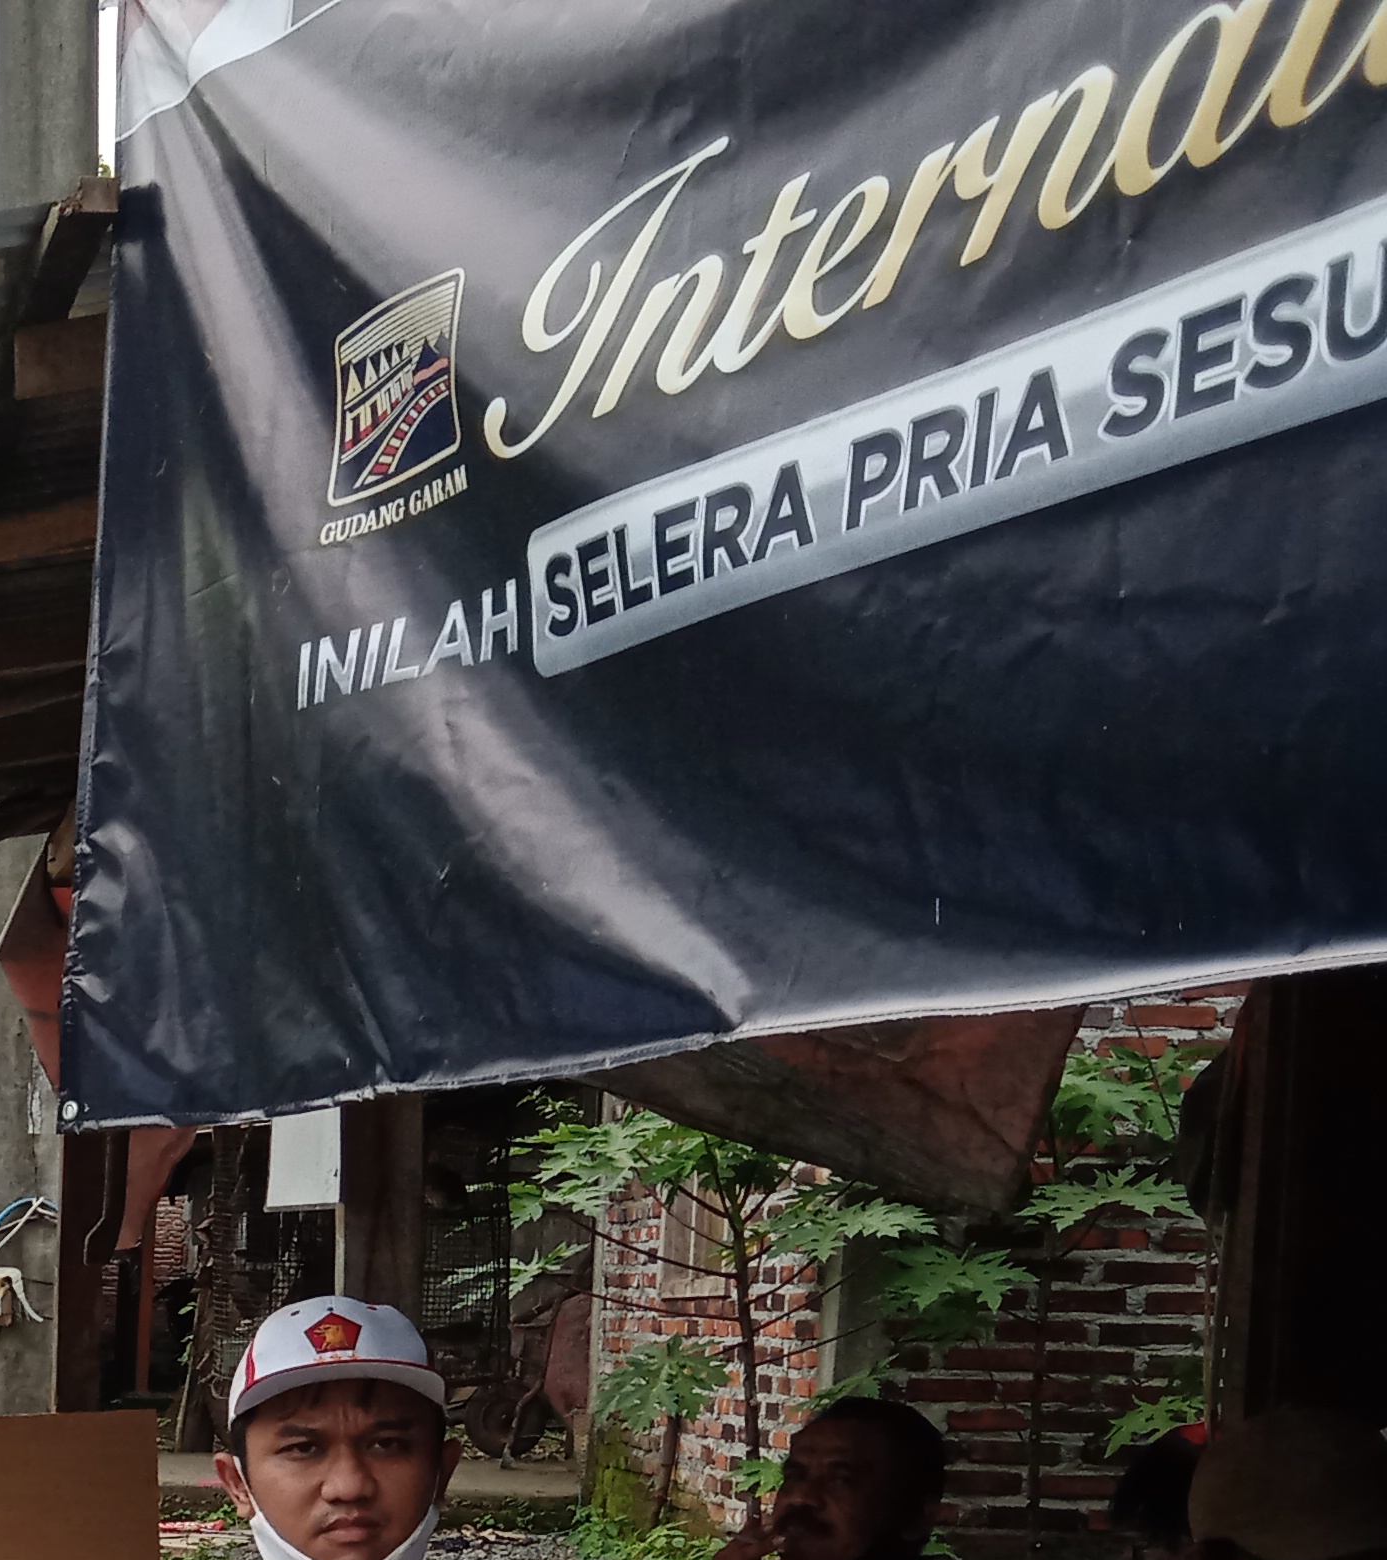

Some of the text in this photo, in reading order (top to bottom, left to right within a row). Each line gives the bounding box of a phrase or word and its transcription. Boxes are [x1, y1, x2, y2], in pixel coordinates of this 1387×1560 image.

[297, 578, 518, 711] INILAH
[545, 459, 817, 637] SELERA
[842, 365, 1074, 535] PRIA
[319, 464, 469, 547] GUDANG GARAM
